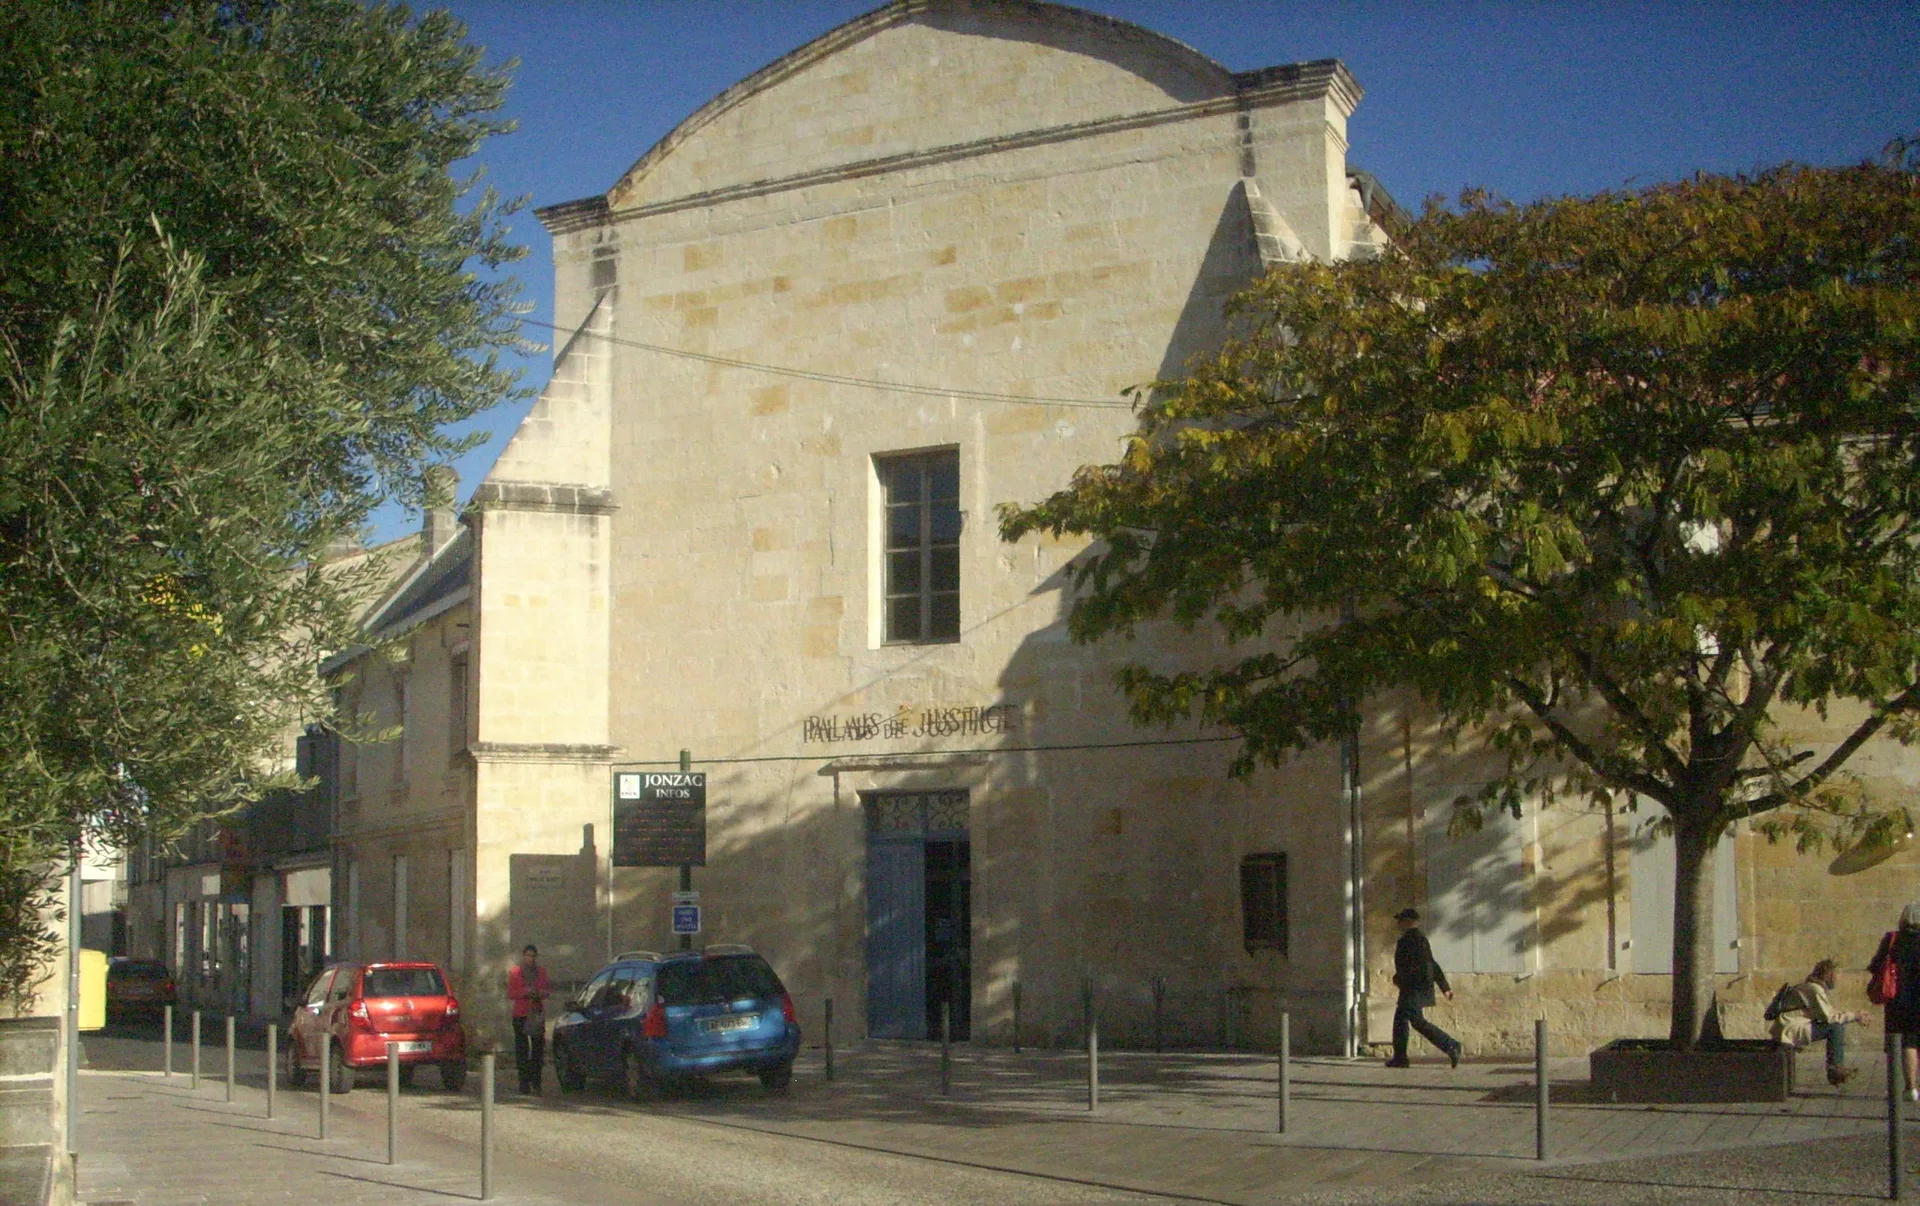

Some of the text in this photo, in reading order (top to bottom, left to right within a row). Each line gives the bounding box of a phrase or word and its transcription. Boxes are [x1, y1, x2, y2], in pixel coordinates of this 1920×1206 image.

[803, 705, 1017, 743] PALAIS DE JUSTICE
[644, 774, 703, 788] JONZAC
[656, 789, 690, 798] INFOS
